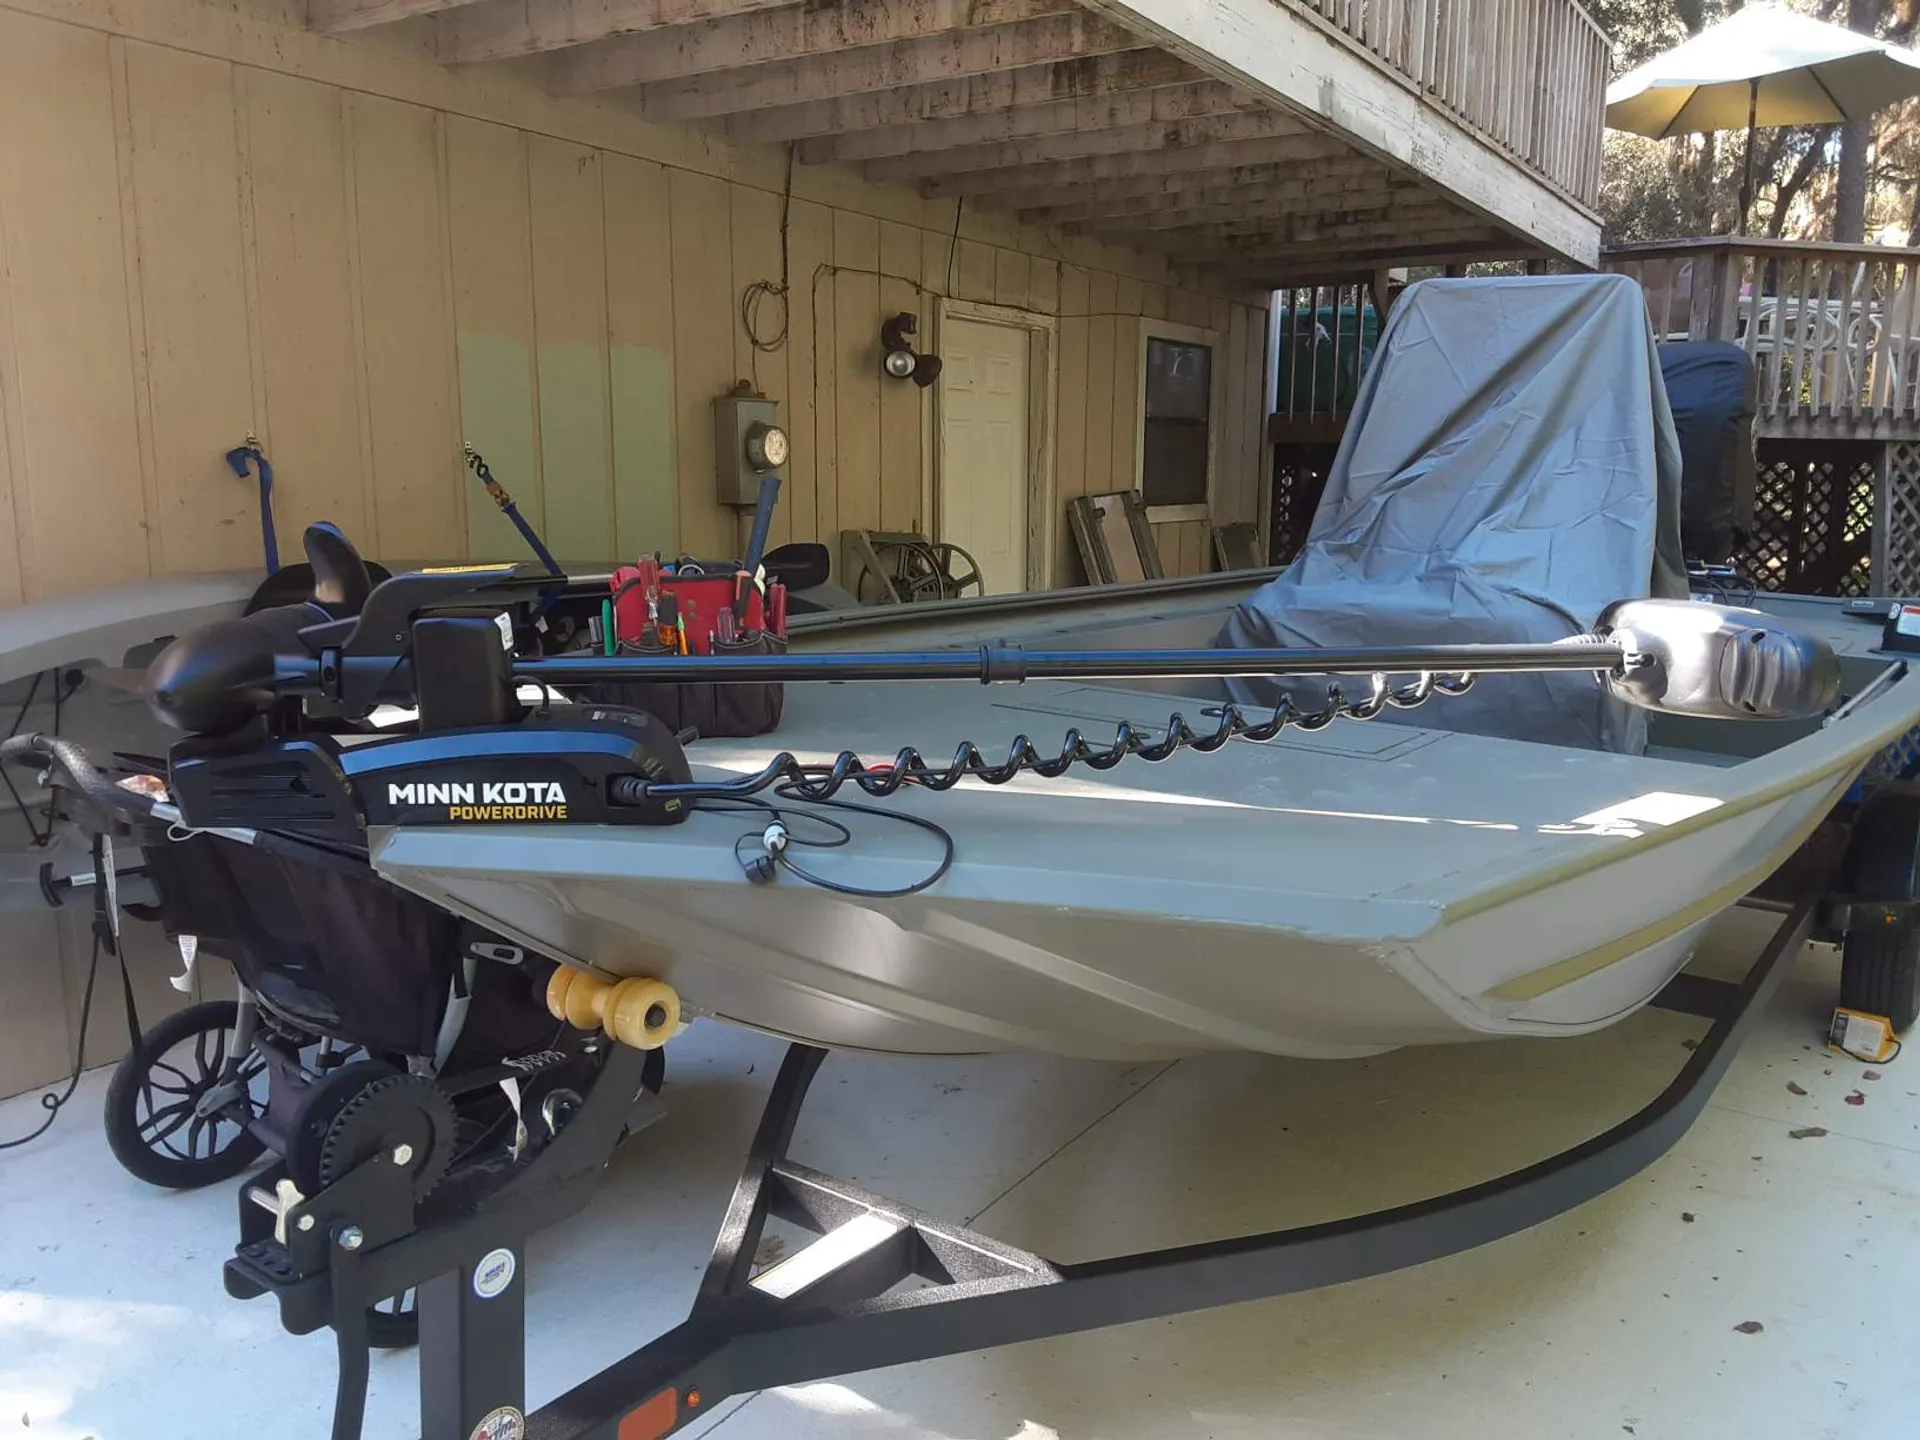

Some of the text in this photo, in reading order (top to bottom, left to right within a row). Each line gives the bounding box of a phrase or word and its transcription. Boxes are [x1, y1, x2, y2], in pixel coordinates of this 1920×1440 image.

[388, 783, 566, 804] MINN KOTA
[450, 805, 567, 820] POWERDRIVE
